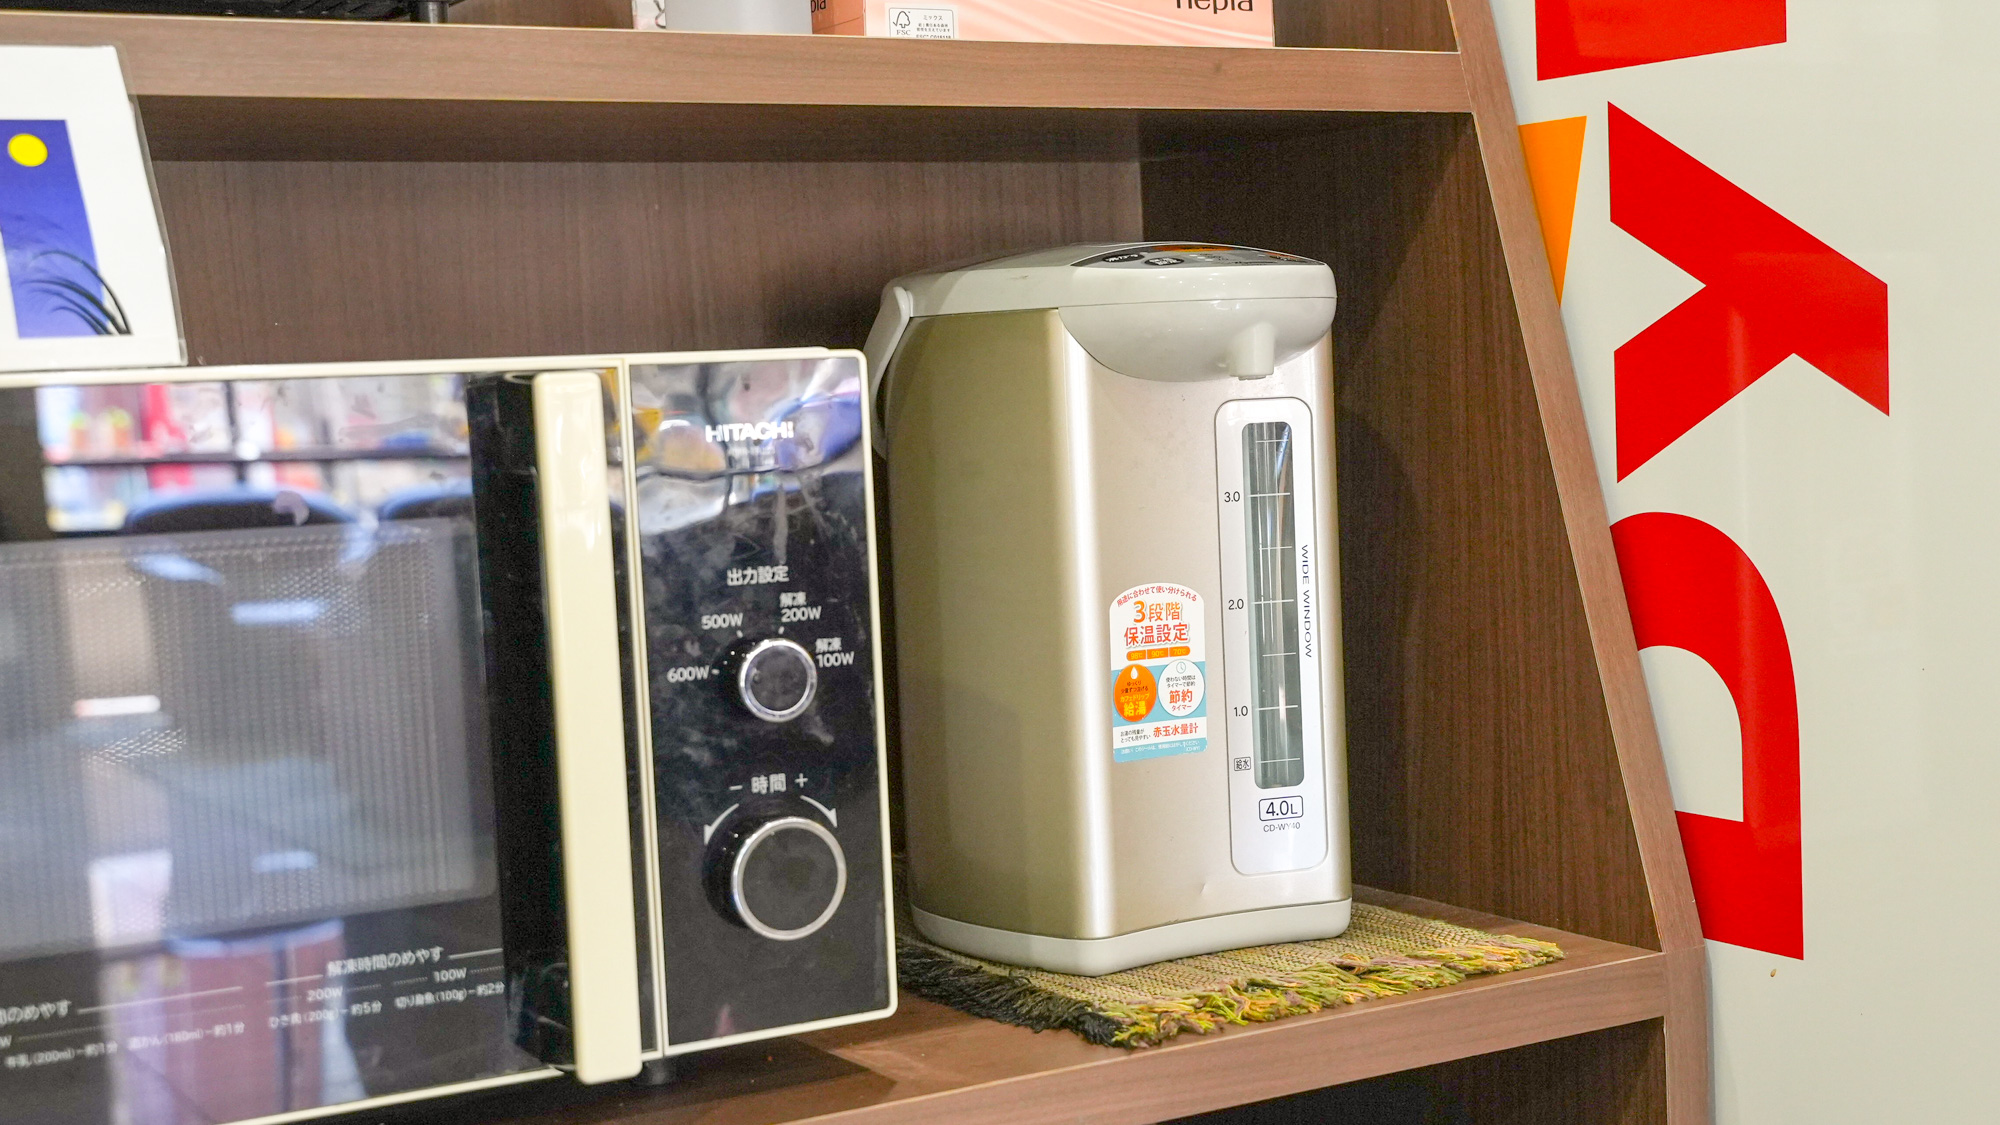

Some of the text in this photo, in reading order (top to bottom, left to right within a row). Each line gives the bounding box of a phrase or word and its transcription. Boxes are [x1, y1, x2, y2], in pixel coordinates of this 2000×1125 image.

[705, 421, 794, 442] HITACHI
[1224, 491, 1240, 502] 3.0
[728, 566, 790, 586] 出力設定
[779, 592, 806, 608] 解凍
[1116, 586, 1197, 607] 用途に合わせて使い分けられる
[1228, 598, 1244, 610] 2.0
[1301, 544, 1312, 658] WIDE WINDOW
[781, 606, 822, 622] 200W
[1133, 600, 1181, 623] 3段階
[701, 612, 744, 630] 500W
[1124, 623, 1188, 646] 保温設定
[815, 637, 842, 653] 解凍
[816, 652, 855, 668] 100W
[667, 666, 710, 683] 600W
[1169, 689, 1193, 704] 節約
[1124, 701, 1146, 717] 給湯
[1172, 704, 1192, 712] タイマー
[1234, 706, 1248, 717] 1.0
[1153, 722, 1198, 738] 赤玉水量計
[751, 773, 786, 794] 時間
[1266, 800, 1298, 816] 4.0L
[1263, 822, 1300, 832] CD-WY40
[326, 946, 444, 977] 解凍時間のめやす
[433, 968, 467, 983] 100W
[306, 986, 343, 1002] 200W
